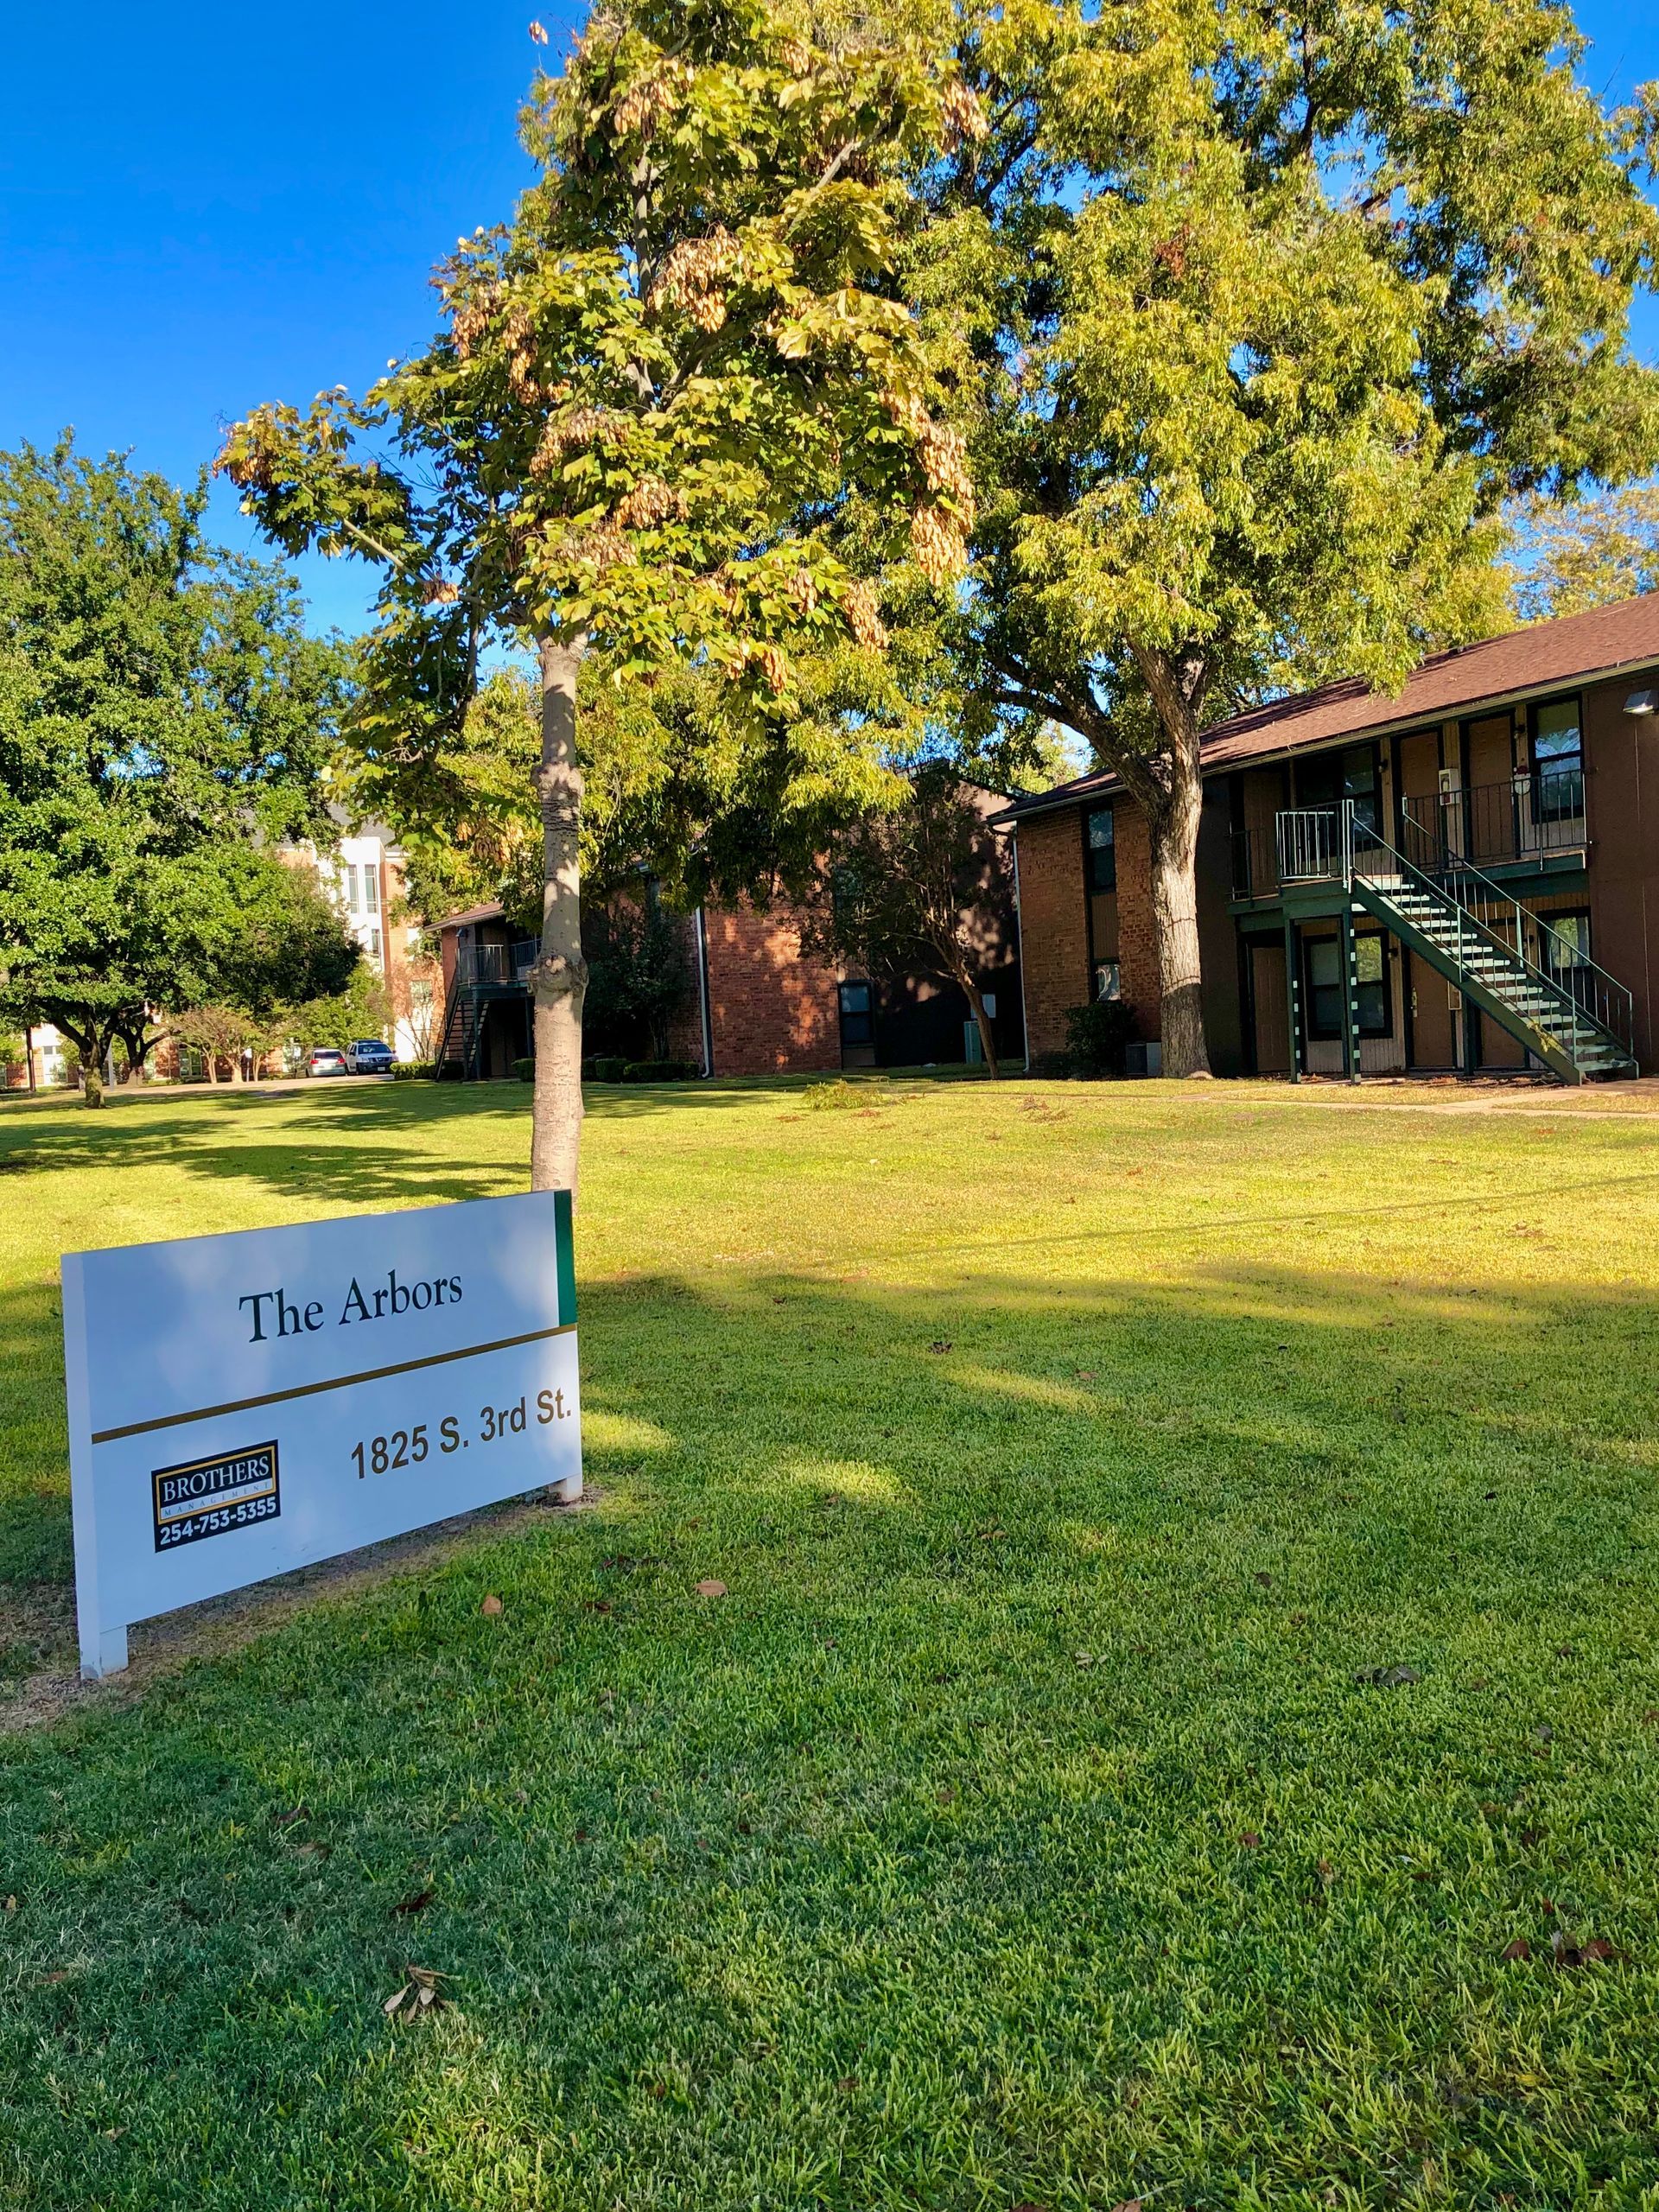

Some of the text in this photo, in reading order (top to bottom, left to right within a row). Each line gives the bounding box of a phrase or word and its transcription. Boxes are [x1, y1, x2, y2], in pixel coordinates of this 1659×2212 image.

[238, 1269, 463, 1343] The Arbors
[351, 1388, 572, 1479] 1825 S. 3rd St.
[163, 1456, 270, 1502] BROTHERS
[163, 1480, 269, 1516] MANAGEMENT
[160, 1496, 276, 1545] 254-753-5355
